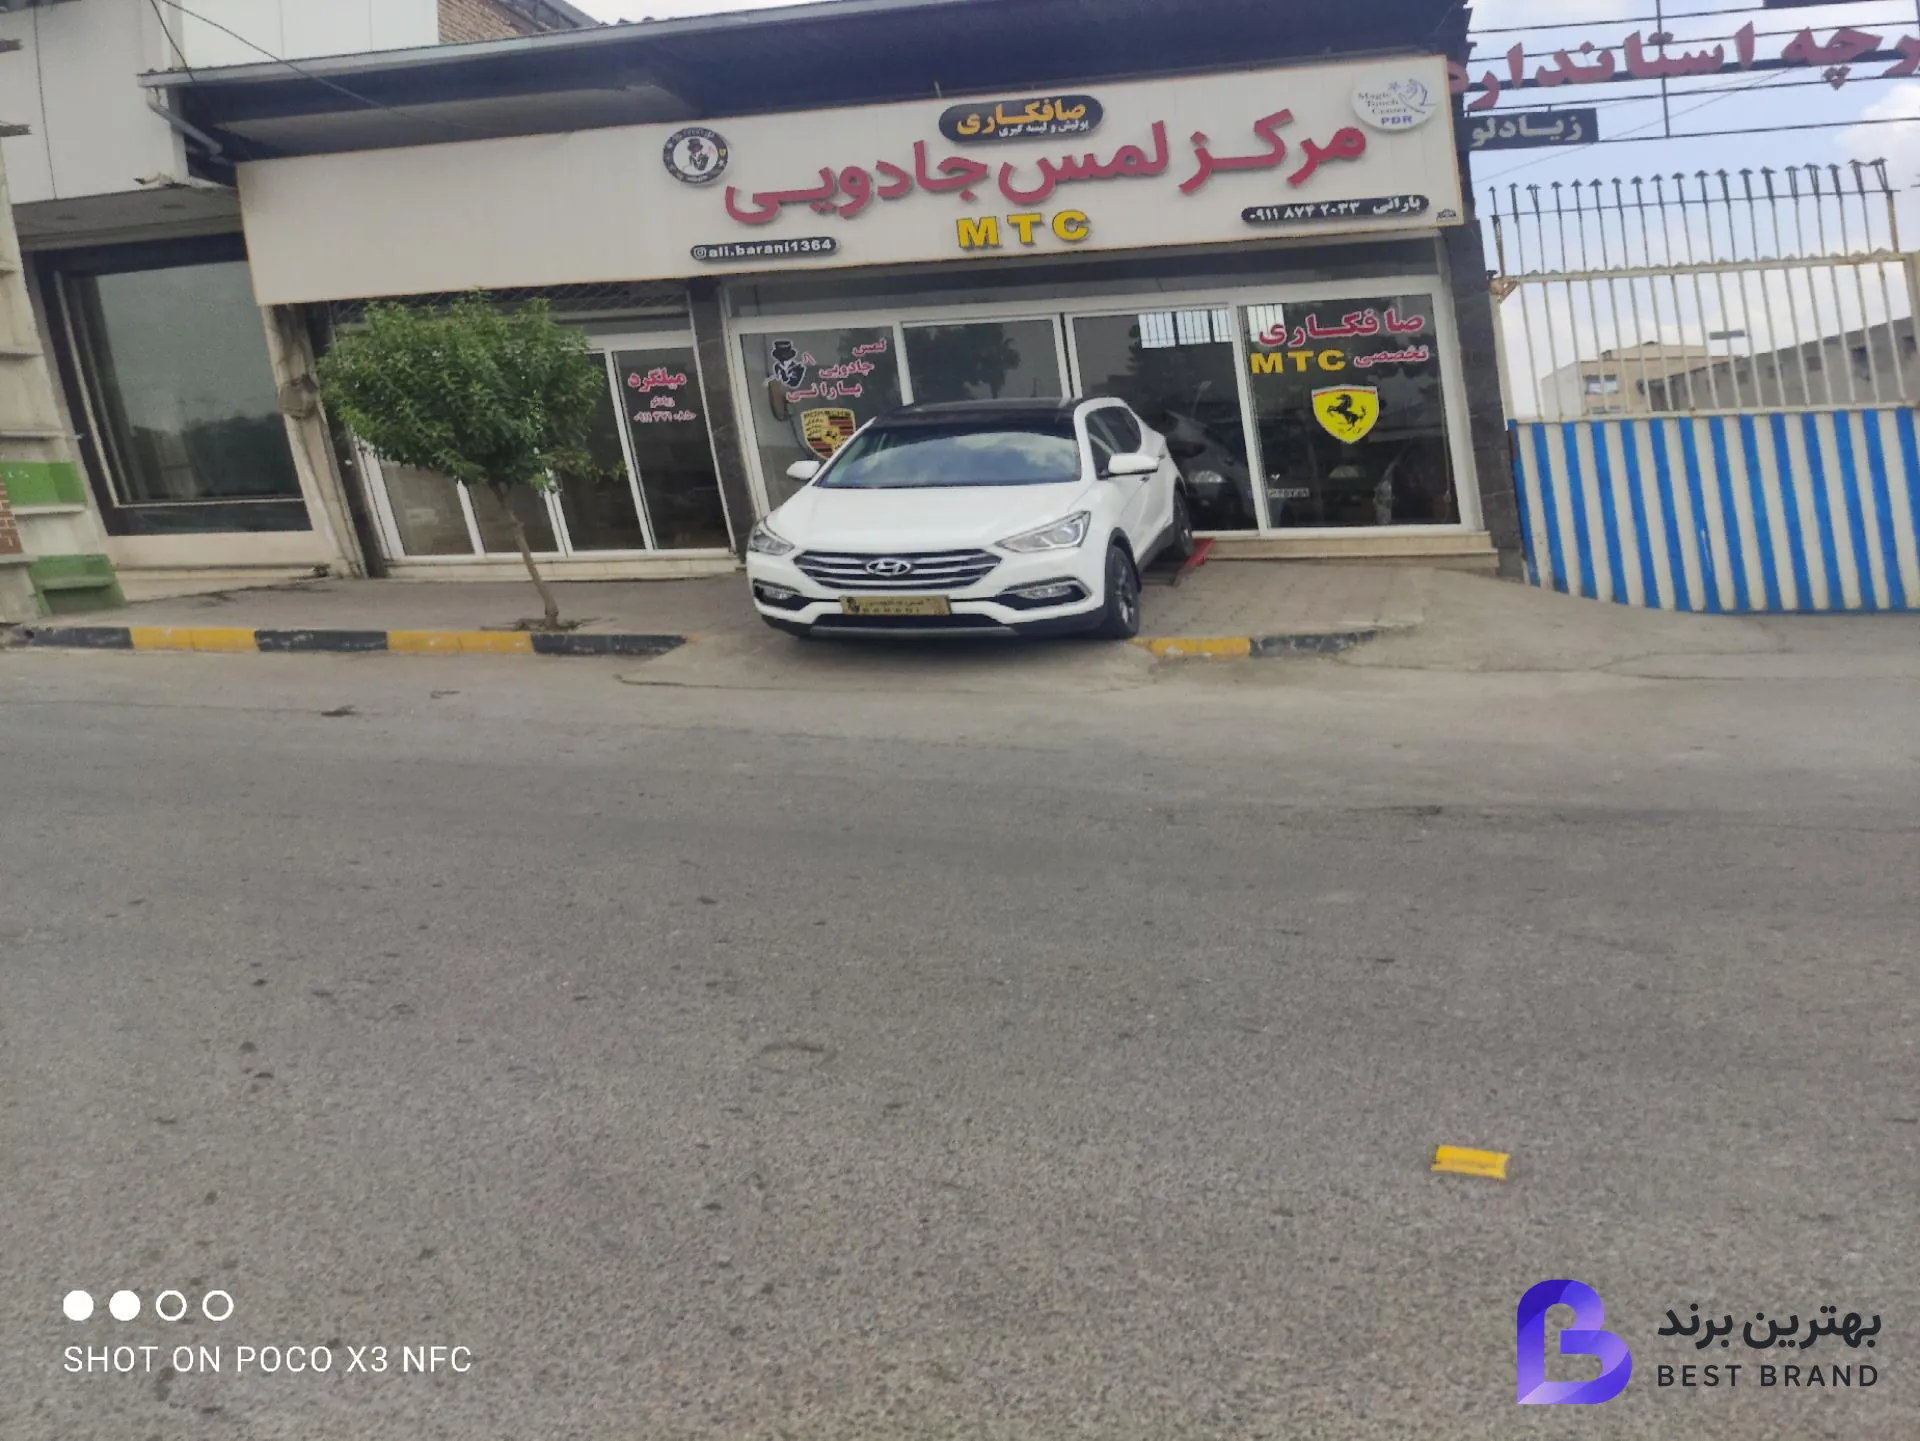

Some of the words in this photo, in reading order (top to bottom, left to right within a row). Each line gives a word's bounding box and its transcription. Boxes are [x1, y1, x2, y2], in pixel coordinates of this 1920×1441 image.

[957, 100, 1086, 135] صافکاری
[1470, 115, 1583, 147] زیادلو
[998, 120, 1169, 205] لمس
[1178, 108, 1367, 195] مرکز
[725, 140, 989, 225] جادویی
[957, 212, 1089, 247] MTC
[1251, 350, 1345, 374] MTC
